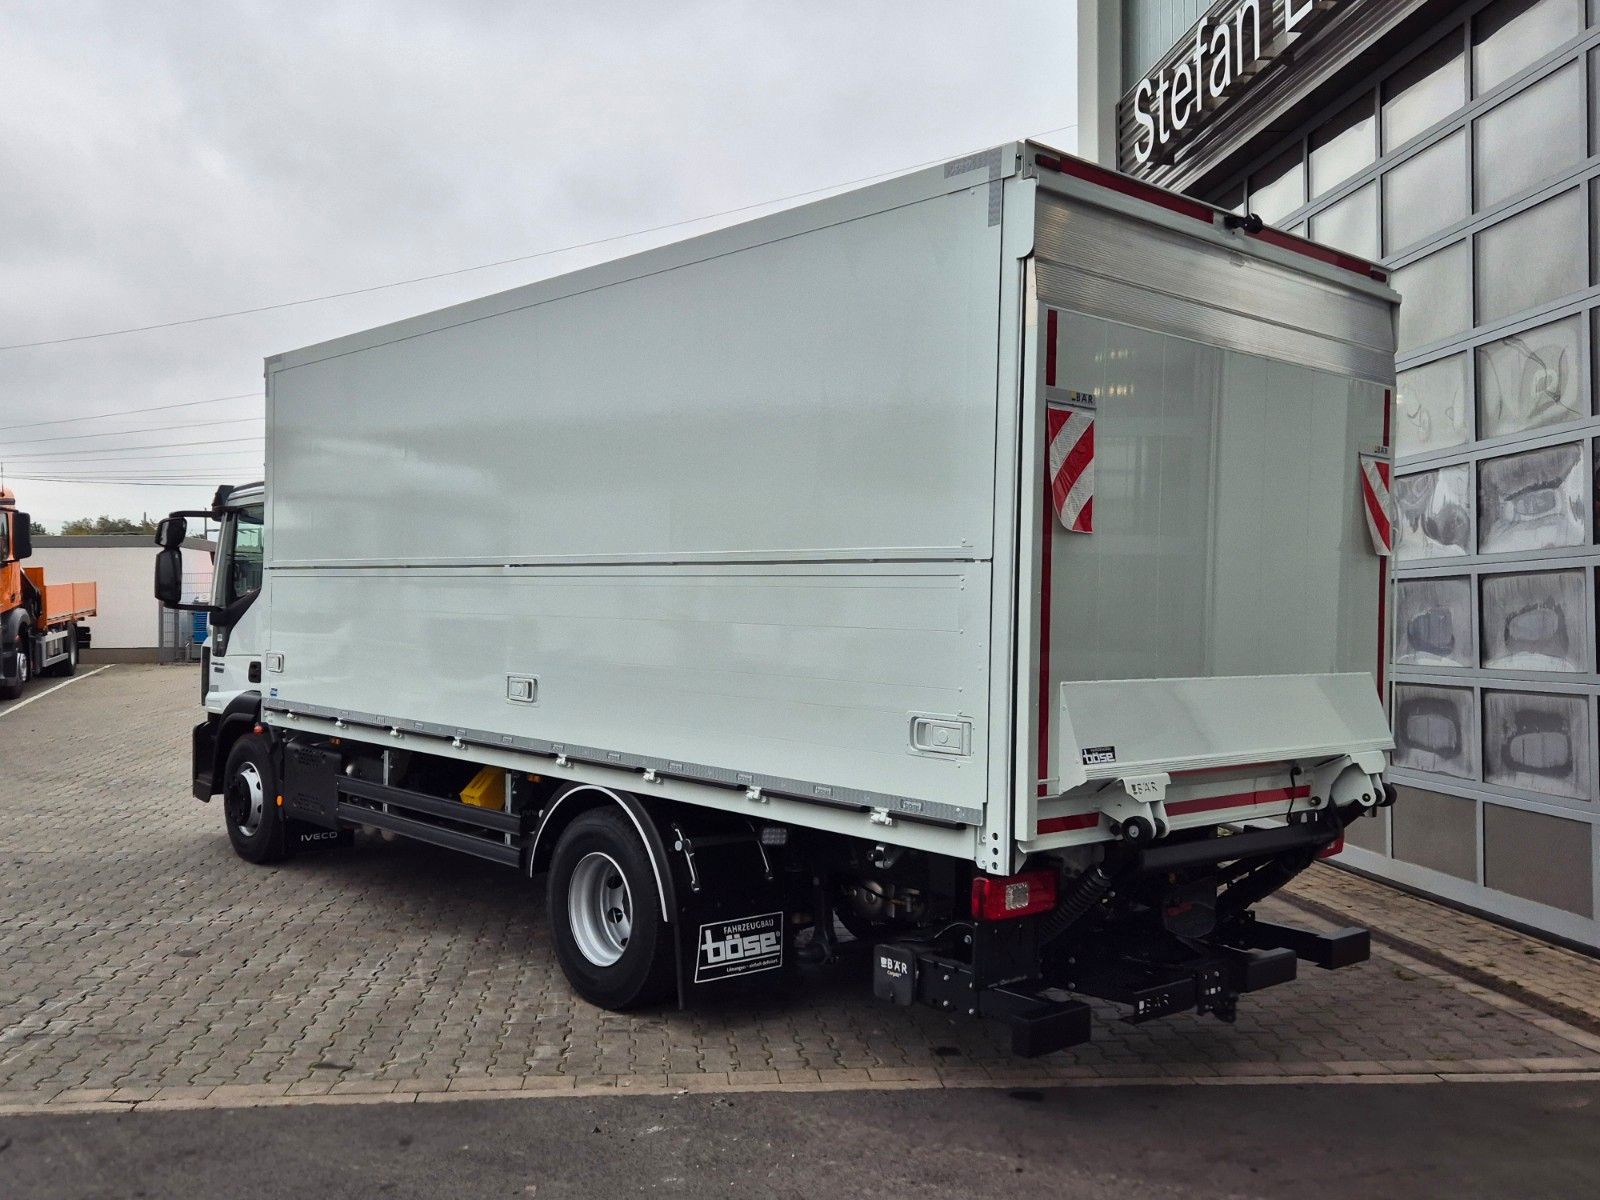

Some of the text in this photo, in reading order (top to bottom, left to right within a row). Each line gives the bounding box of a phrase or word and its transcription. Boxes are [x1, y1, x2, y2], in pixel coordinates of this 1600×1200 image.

[1134, 0, 1261, 164] Stefan
[300, 831, 338, 842] IVECO
[723, 920, 774, 934] FAHRZEUGBAU
[887, 958, 908, 975] BÄR
